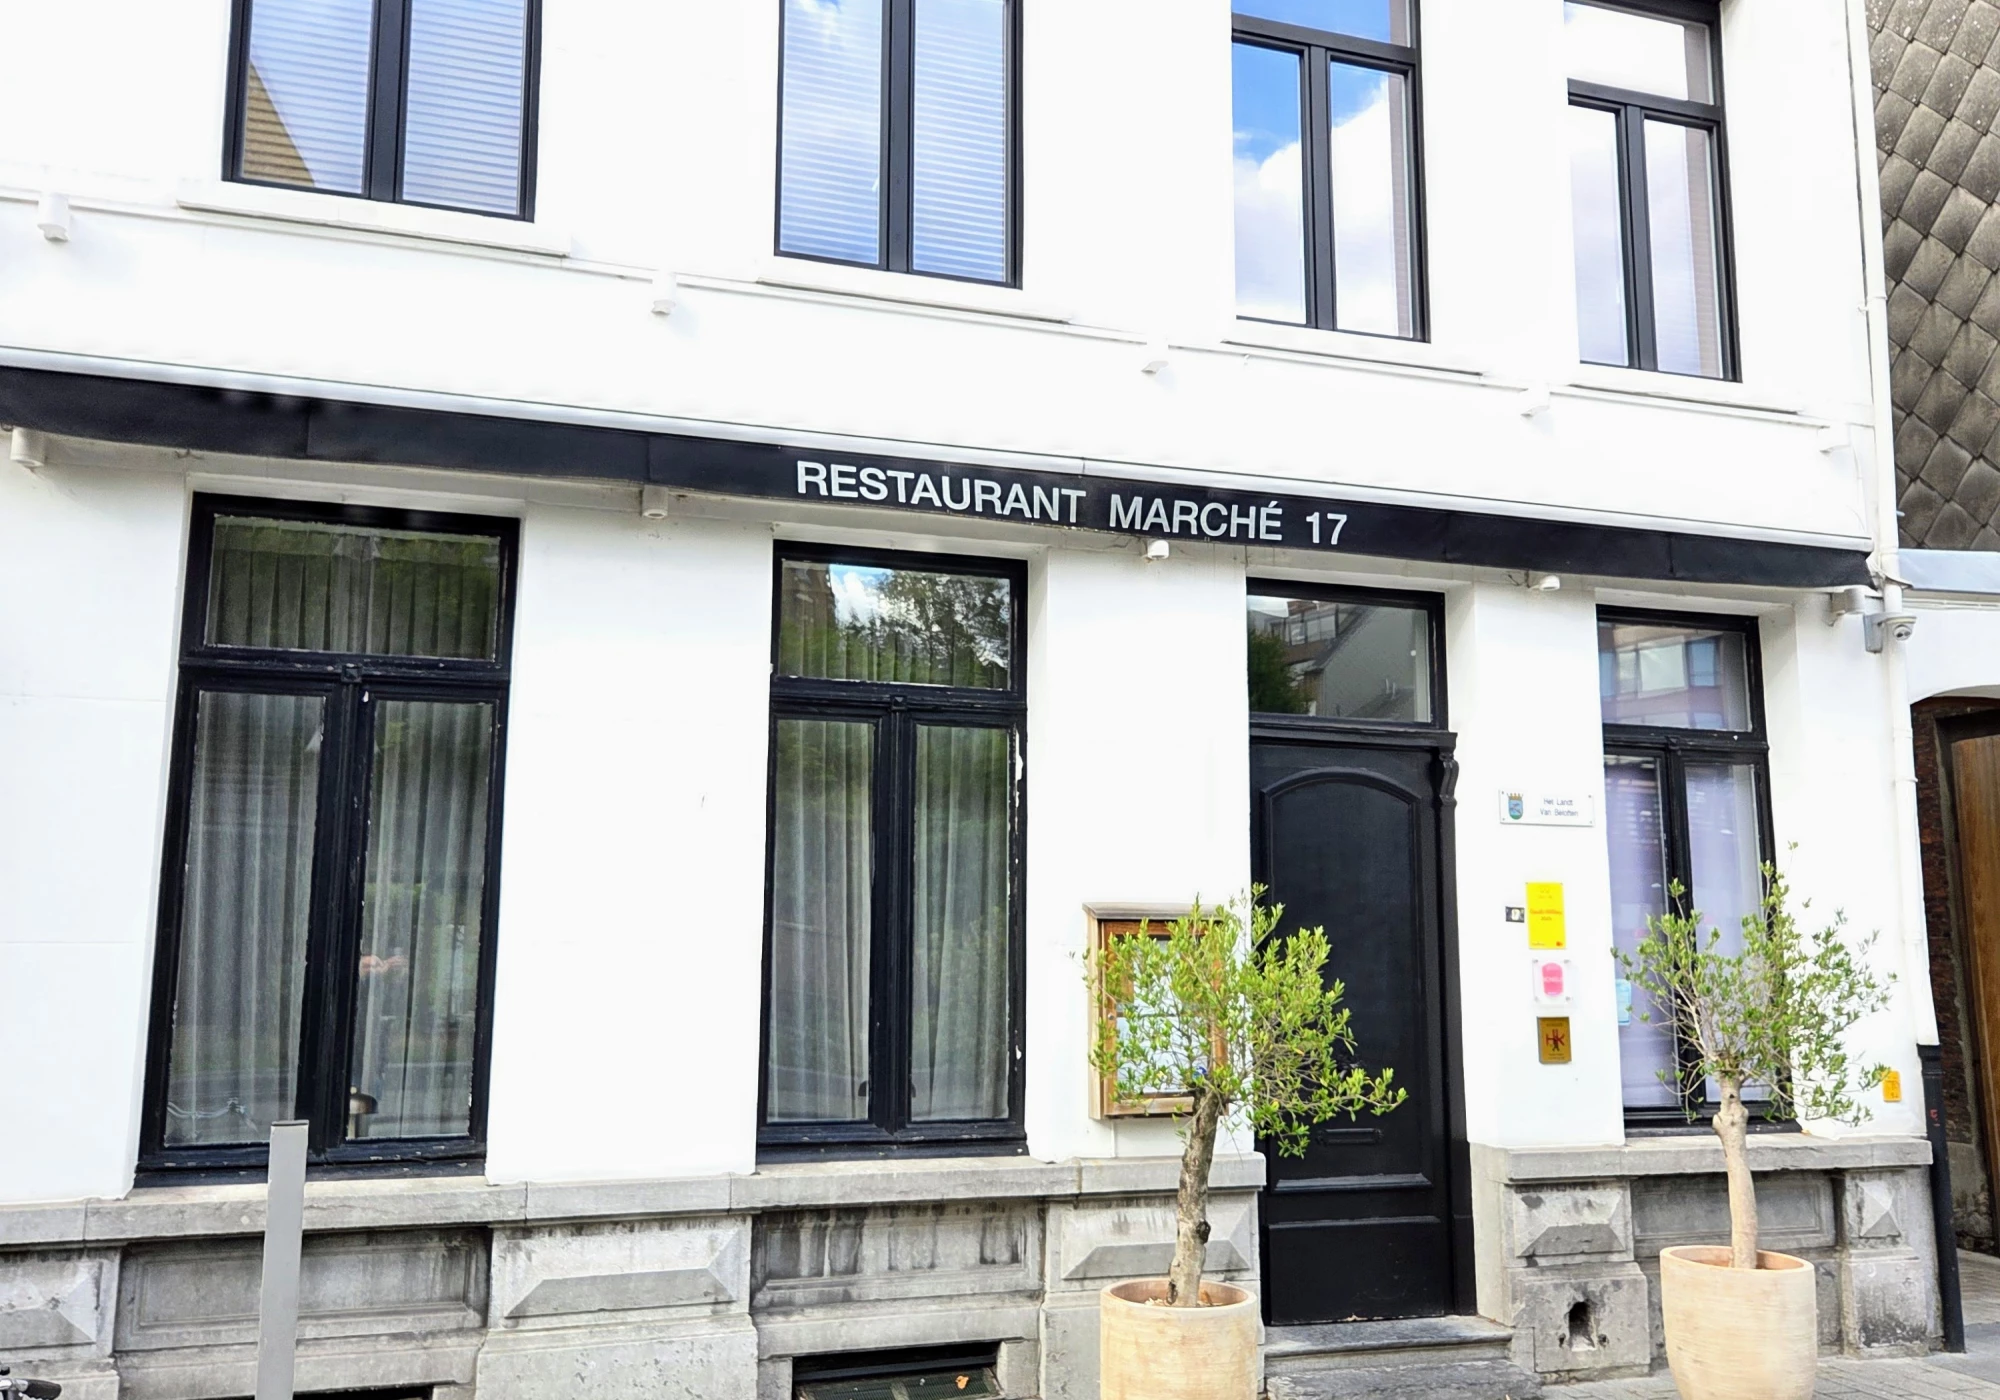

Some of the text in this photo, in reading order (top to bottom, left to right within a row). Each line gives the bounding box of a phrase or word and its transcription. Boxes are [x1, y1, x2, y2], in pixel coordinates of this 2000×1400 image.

[797, 460, 1348, 545] RESTAURANT MARCHÉ 17
